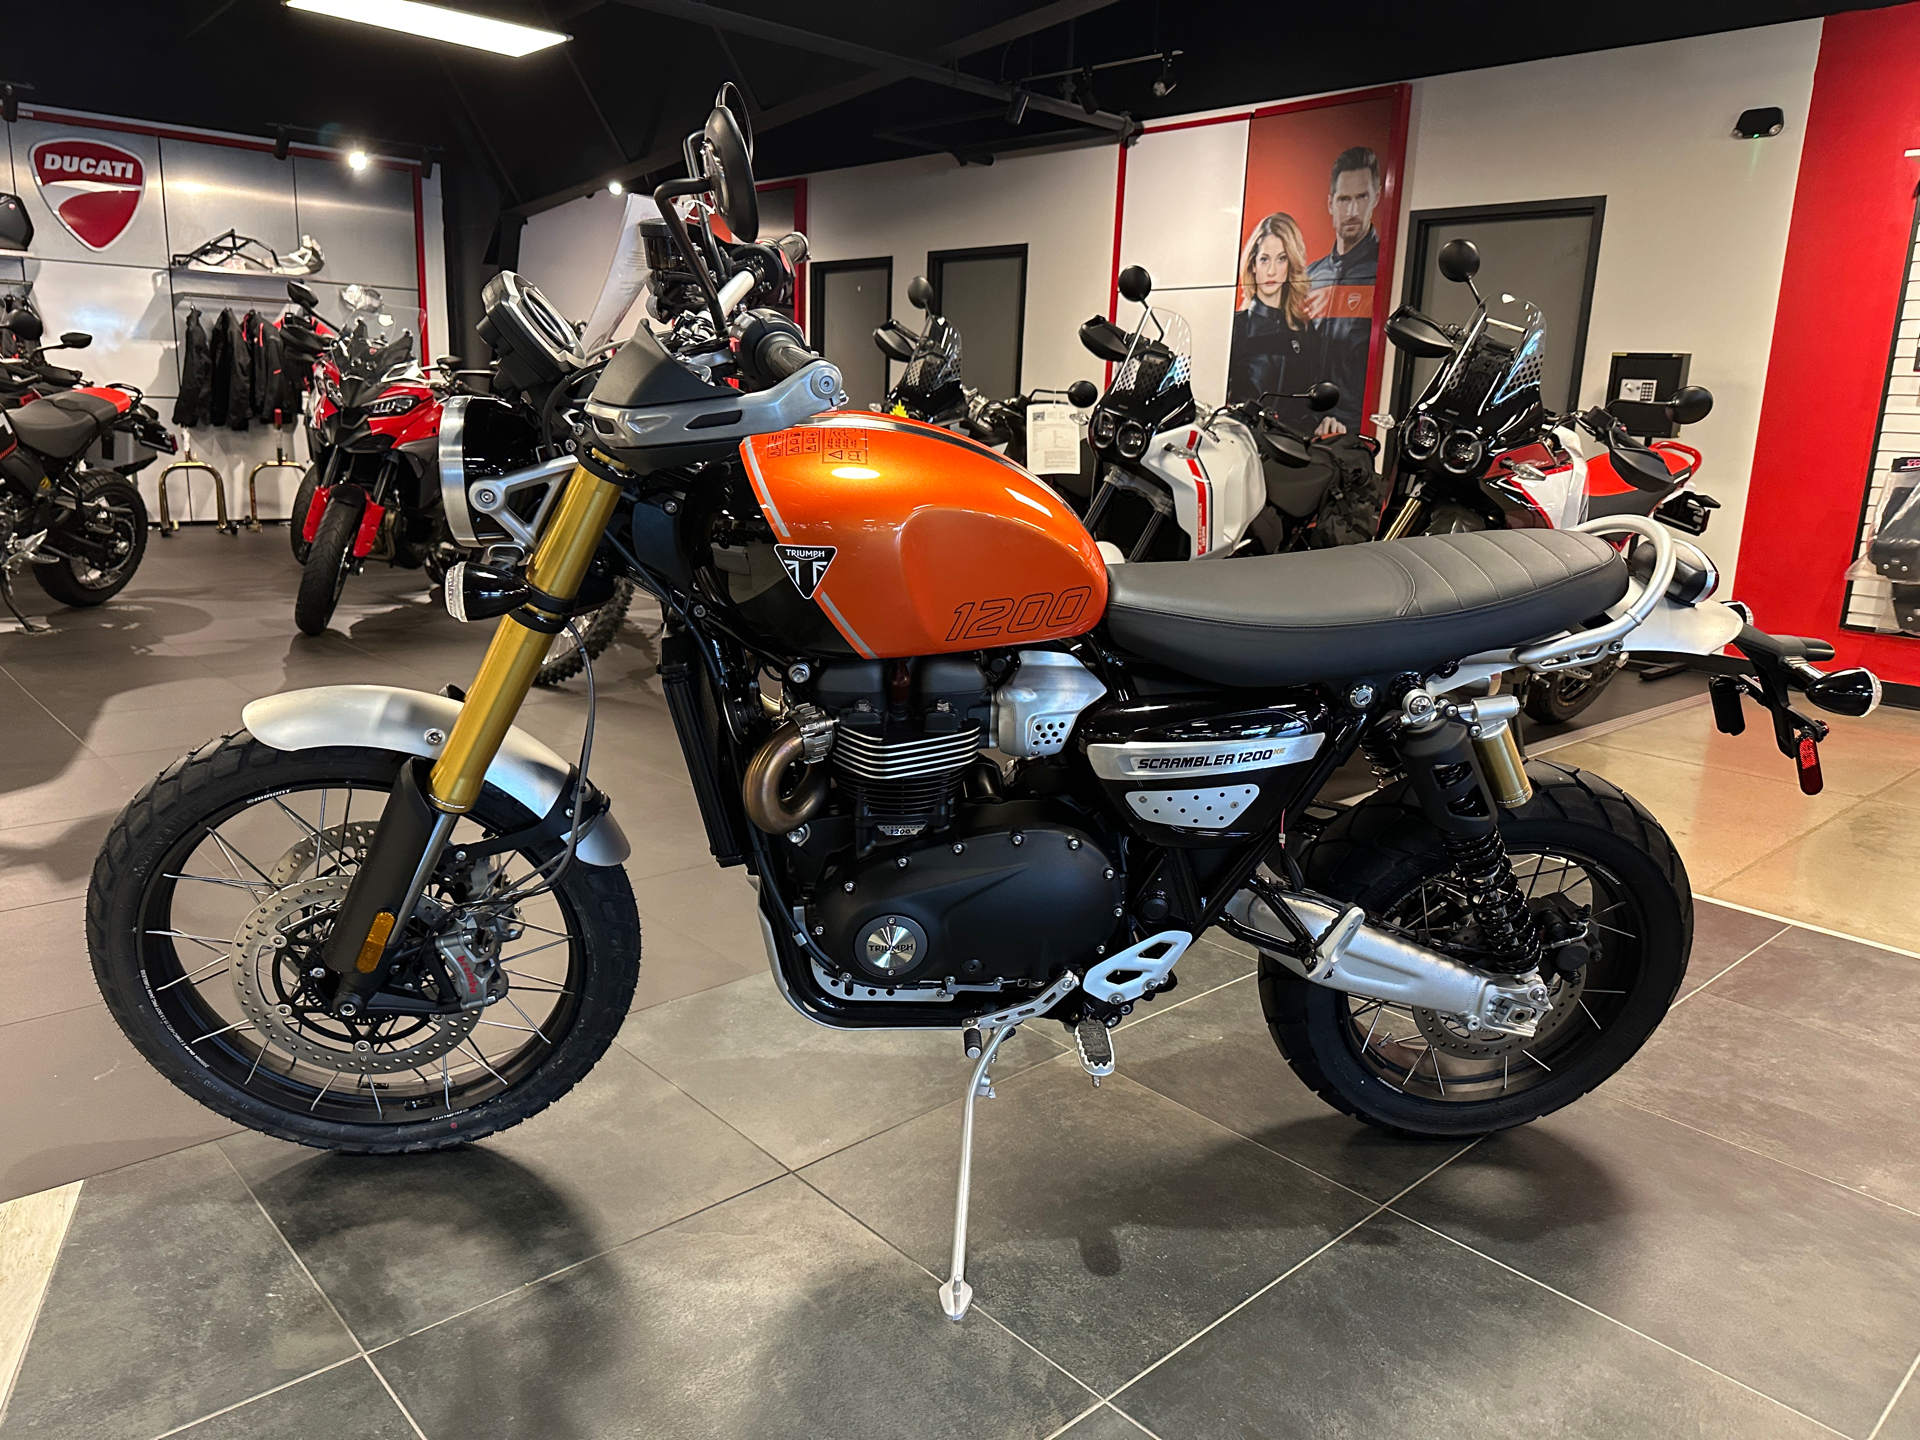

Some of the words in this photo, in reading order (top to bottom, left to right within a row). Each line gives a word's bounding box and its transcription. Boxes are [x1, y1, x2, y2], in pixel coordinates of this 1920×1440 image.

[44, 152, 134, 179] DUCATI
[785, 548, 825, 558] TRIUMPH
[945, 586, 1092, 642] 1200
[1137, 753, 1236, 769] SCRAMBLER
[1236, 749, 1273, 763] 1200
[868, 944, 914, 952] TRIUMPH
[457, 955, 478, 994] brembo
